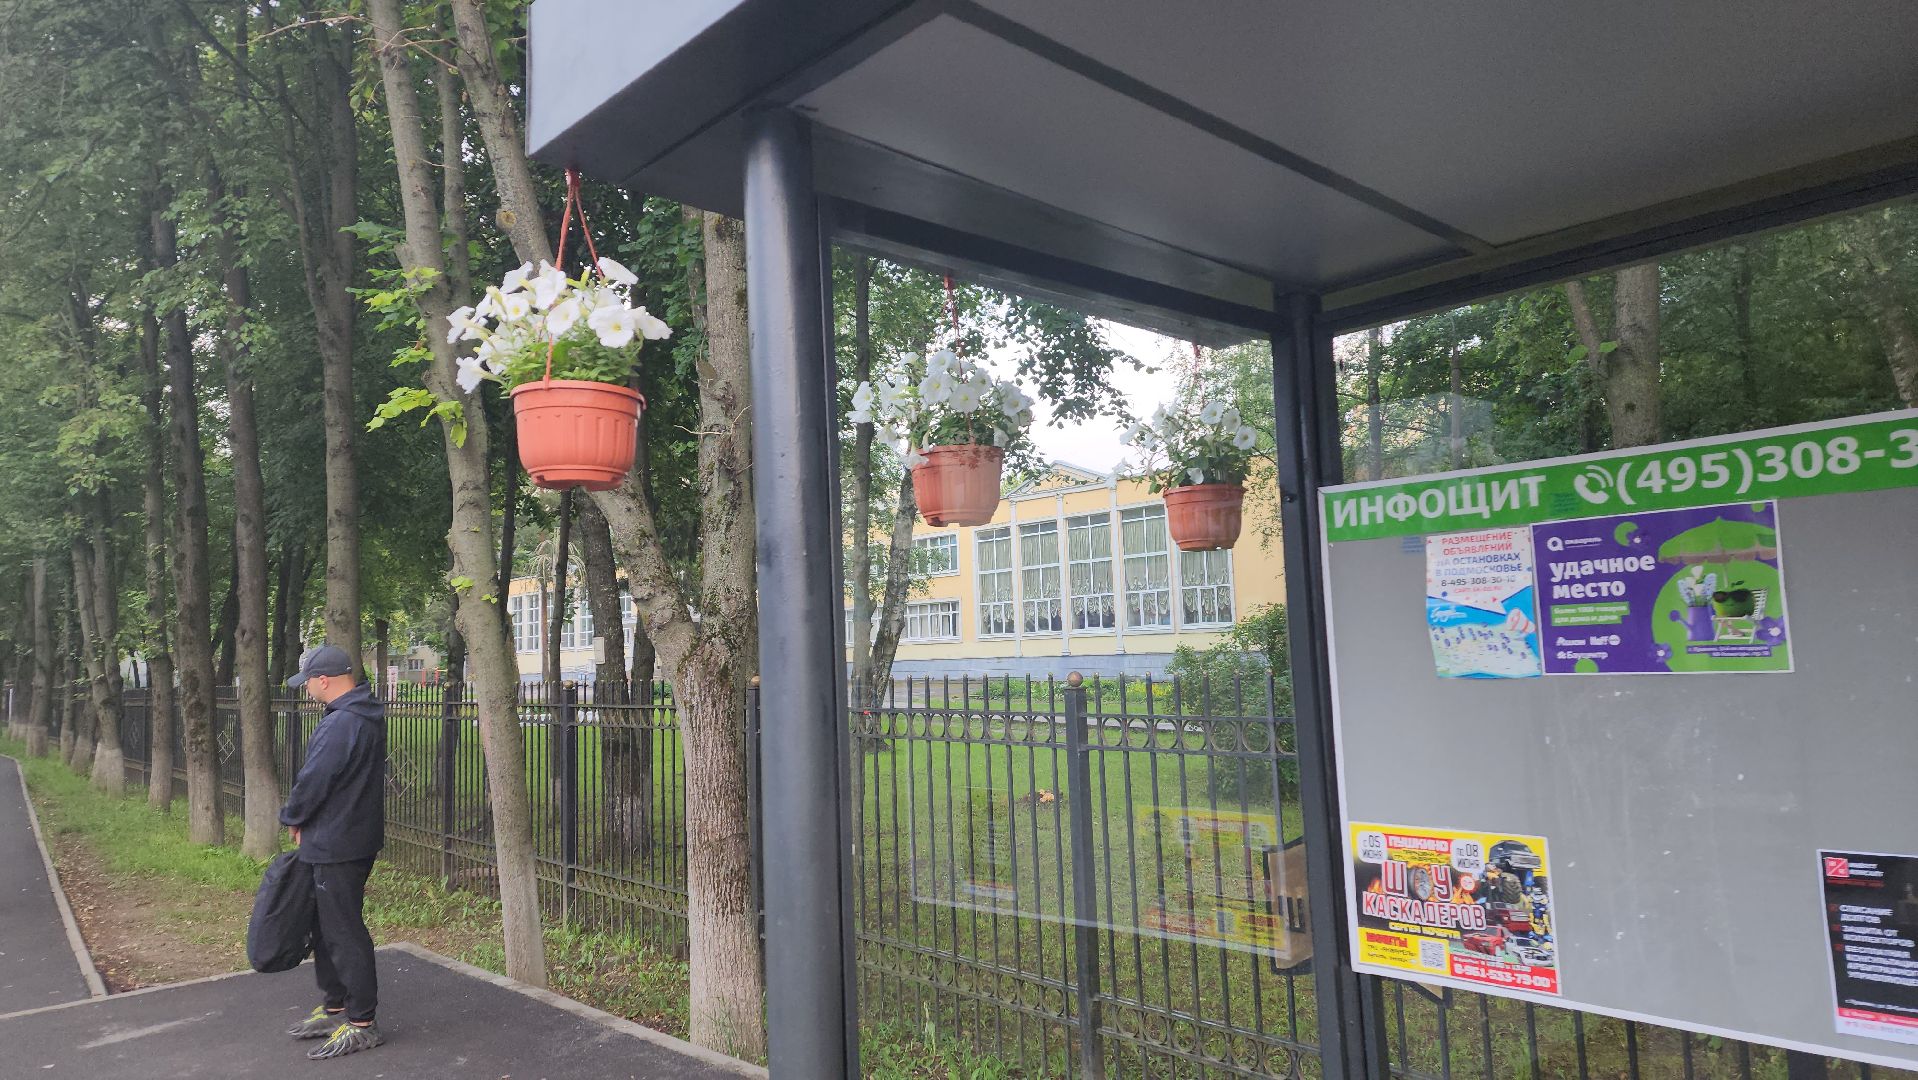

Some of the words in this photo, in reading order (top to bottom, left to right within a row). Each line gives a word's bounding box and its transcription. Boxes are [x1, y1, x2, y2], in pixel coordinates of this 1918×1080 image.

[1333, 475, 1546, 528] ИНФОЩИТ
[1441, 532, 1512, 544] РАЗМЕЩЕНИЕ
[1443, 543, 1512, 556] ОБЪЯВЛЕНИЙ
[1453, 553, 1521, 565] ОСТАНОВКАХ
[1444, 563, 1522, 576] ПОДМОСКОВЬЕ
[1548, 555, 1656, 582] удачное
[1553, 580, 1626, 599] место
[1368, 835, 1381, 848] 05
[1388, 835, 1449, 852] ПУШКИНО
[1465, 843, 1478, 858] 08
[1362, 891, 1486, 930] КАСКАДЕРОВ
